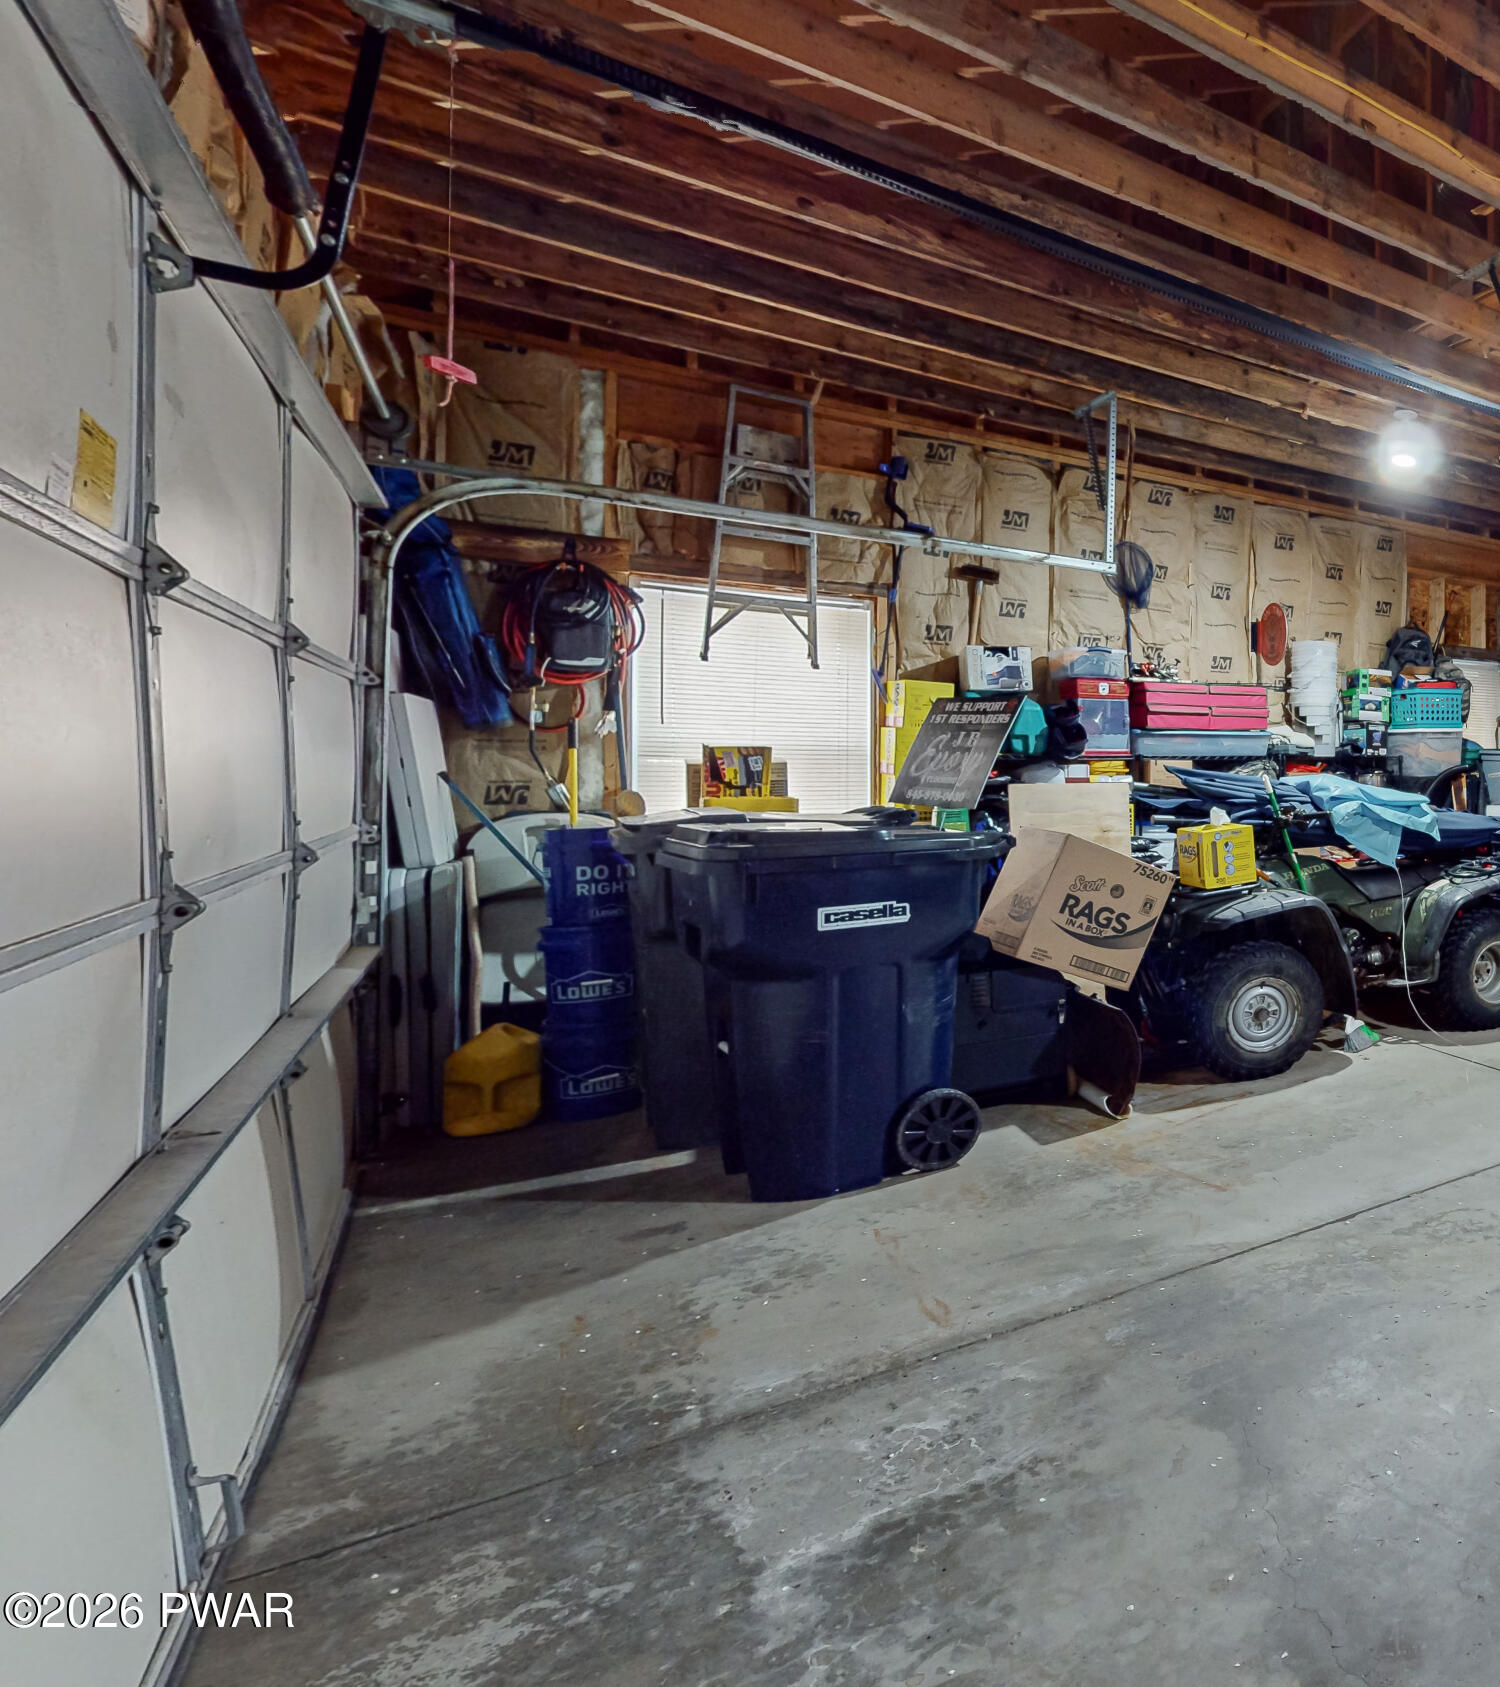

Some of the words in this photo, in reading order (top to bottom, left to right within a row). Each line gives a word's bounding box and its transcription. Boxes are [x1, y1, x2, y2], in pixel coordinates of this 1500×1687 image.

[925, 442, 955, 461] JM
[1002, 509, 1029, 529] JM
[999, 600, 1027, 618] JM
[1211, 656, 1232, 670] JM
[945, 702, 960, 711] WE
[961, 702, 1008, 712] SUPPORT
[930, 714, 947, 723] 1ST
[948, 713, 1011, 724] RESPONDERS
[576, 864, 609, 881] DO
[1132, 863, 1168, 884] 75260
[576, 881, 628, 896] RIGH
[1069, 875, 1106, 892] Scott
[824, 903, 907, 925] casella
[1059, 893, 1131, 934] RAGS
[1066, 918, 1076, 927] IN
[1077, 921, 1084, 929] A
[1085, 925, 1104, 936] BOX
